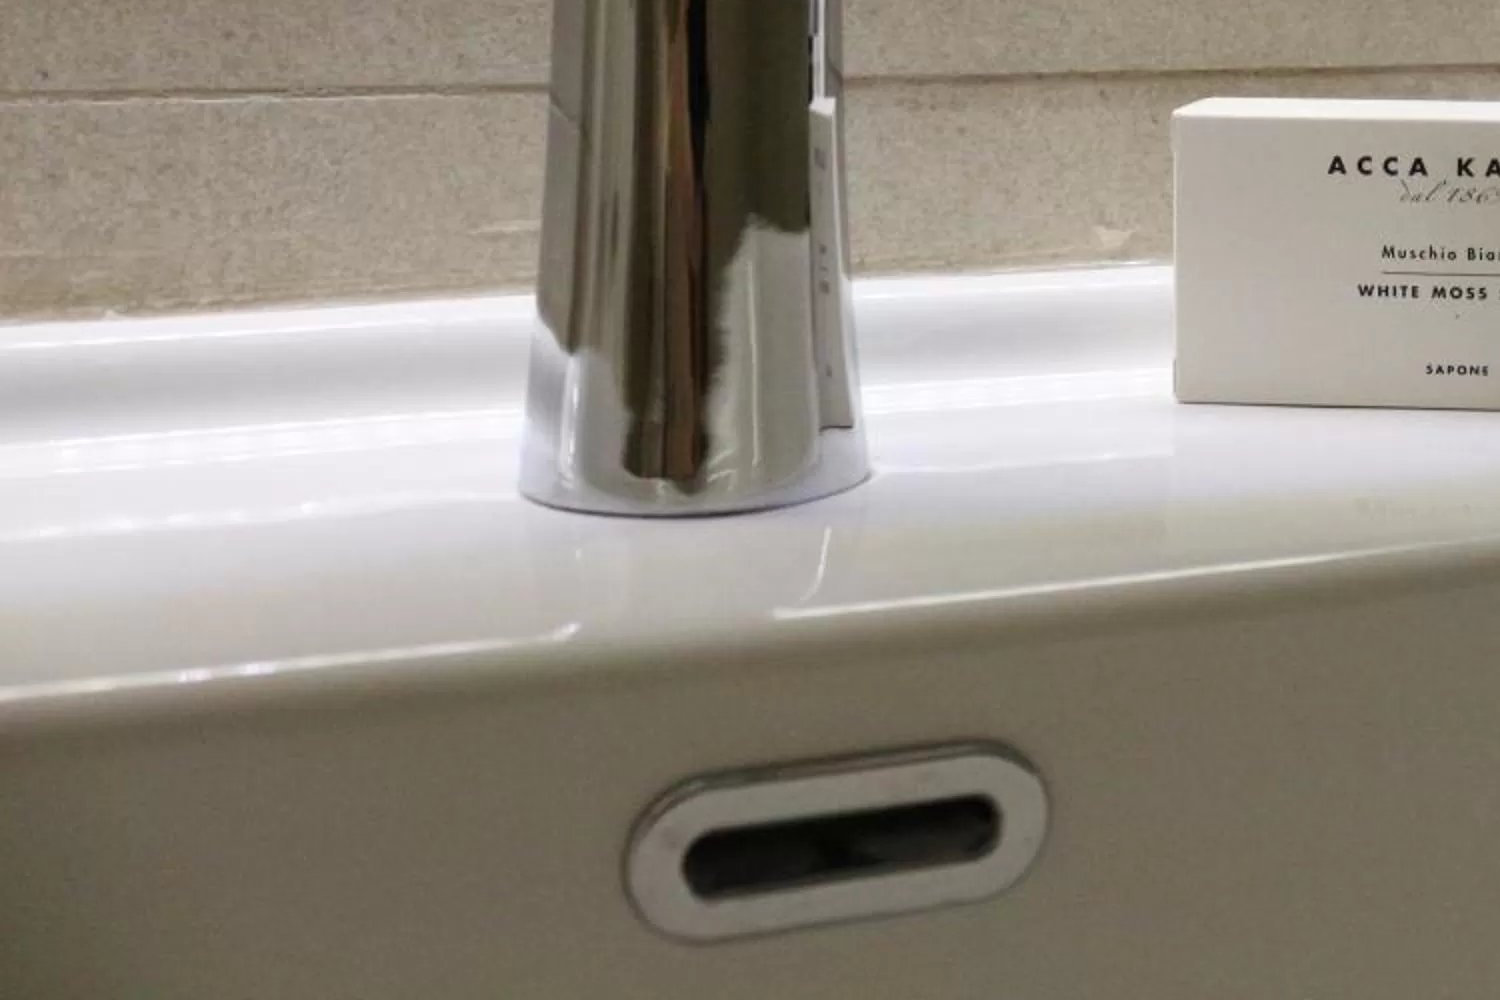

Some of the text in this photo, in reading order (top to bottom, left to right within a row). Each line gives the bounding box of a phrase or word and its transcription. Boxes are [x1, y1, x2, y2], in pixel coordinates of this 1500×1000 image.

[1327, 155, 1428, 176] ACCA
[1381, 244, 1457, 261] Muschio
[1358, 284, 1420, 299] WHITE
[1432, 285, 1487, 300] MOSS
[1426, 365, 1489, 376] SAPONE
